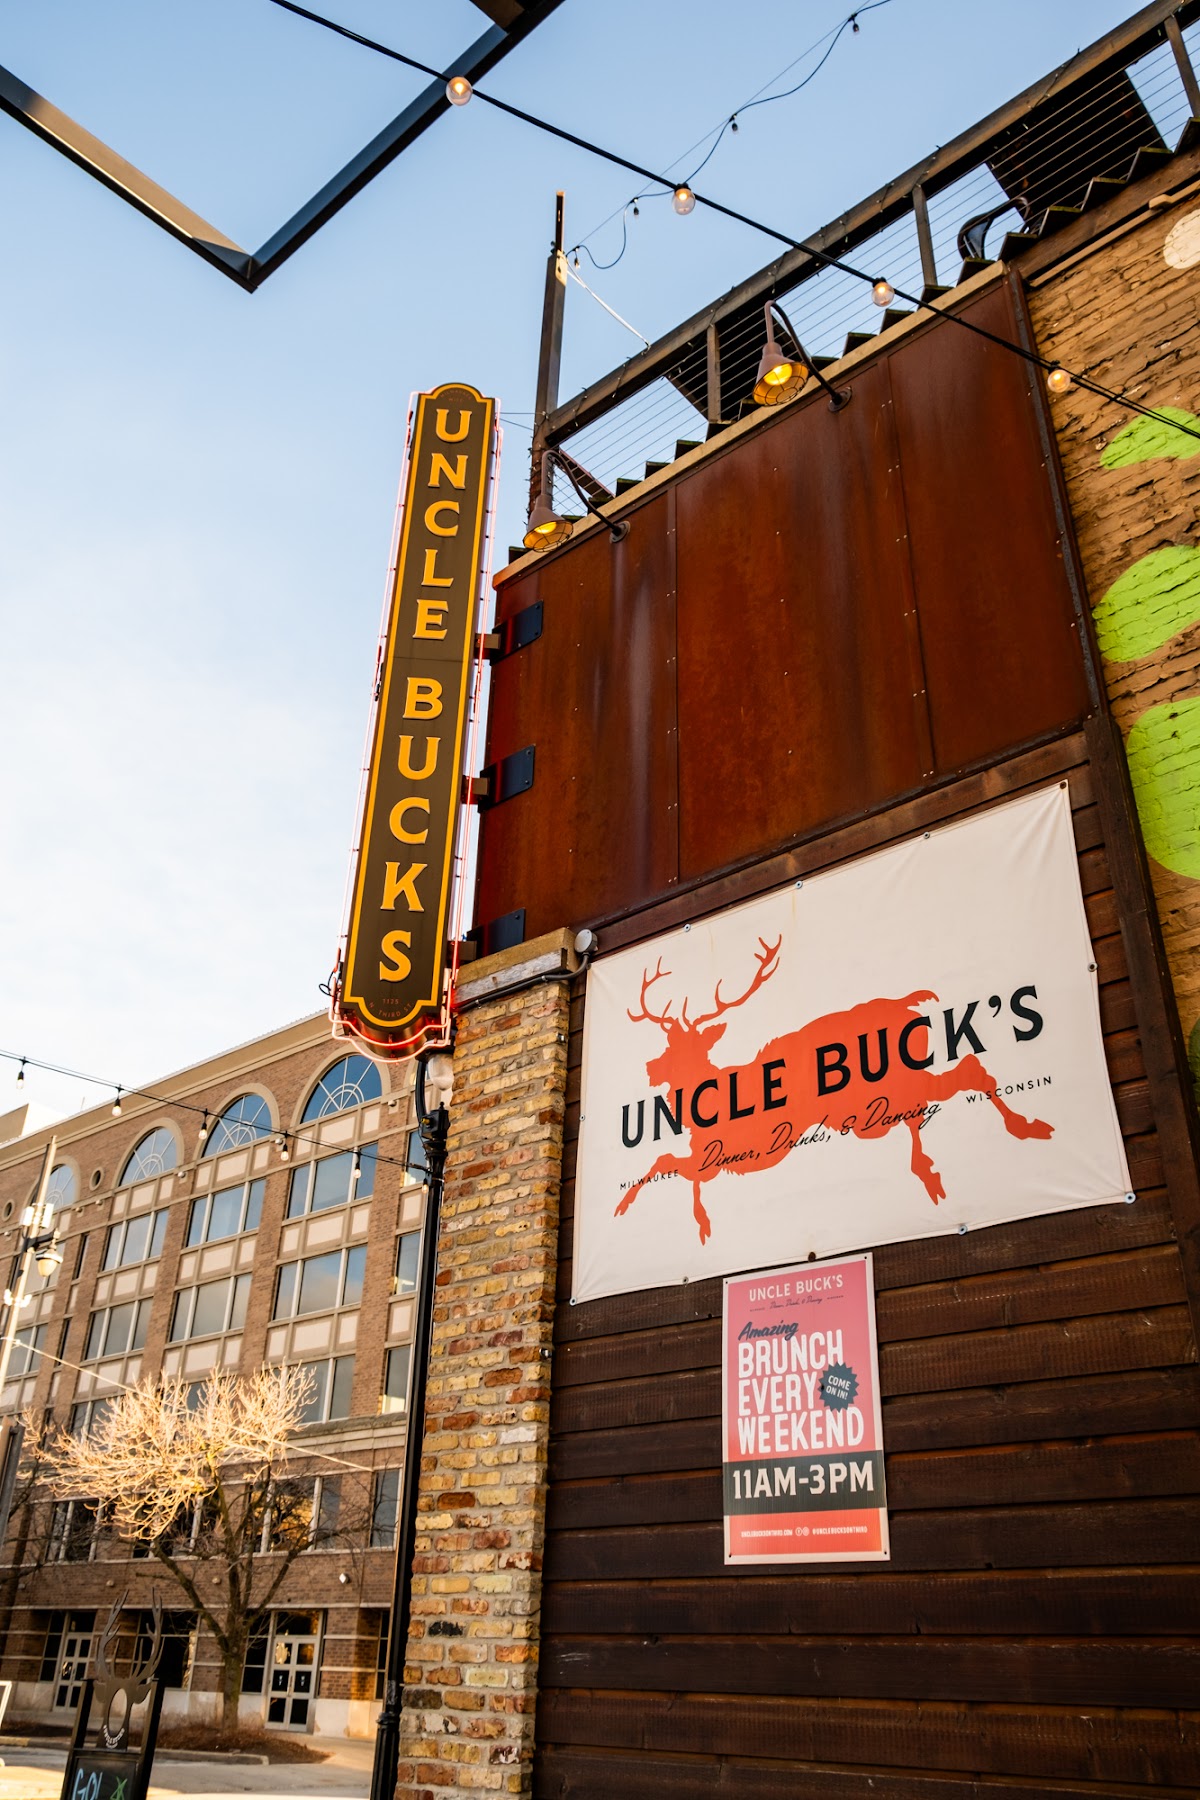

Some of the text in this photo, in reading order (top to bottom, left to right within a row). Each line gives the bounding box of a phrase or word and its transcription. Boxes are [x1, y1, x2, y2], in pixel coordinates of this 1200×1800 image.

[379, 408, 473, 983] UNCLE BUCKS
[378, 1009, 401, 1018] THIRD
[621, 985, 1045, 1149] UNCLE BUCK'S
[965, 1075, 1053, 1104] WISCONSIN
[698, 1096, 942, 1172] Dinner, Drinks, & Dancing
[619, 1169, 679, 1191] MILWAUKEE
[749, 1283, 791, 1302] UNCLE
[796, 1274, 844, 1295] BUCK'S
[738, 1320, 799, 1341] Amazing
[738, 1329, 844, 1379] BRUNCH
[738, 1371, 818, 1417] EVERY
[825, 1385, 849, 1400] ON IN!
[828, 1375, 851, 1391] COME
[737, 1406, 865, 1456] WEEKEND
[732, 1460, 875, 1500] 11AM-3PM
